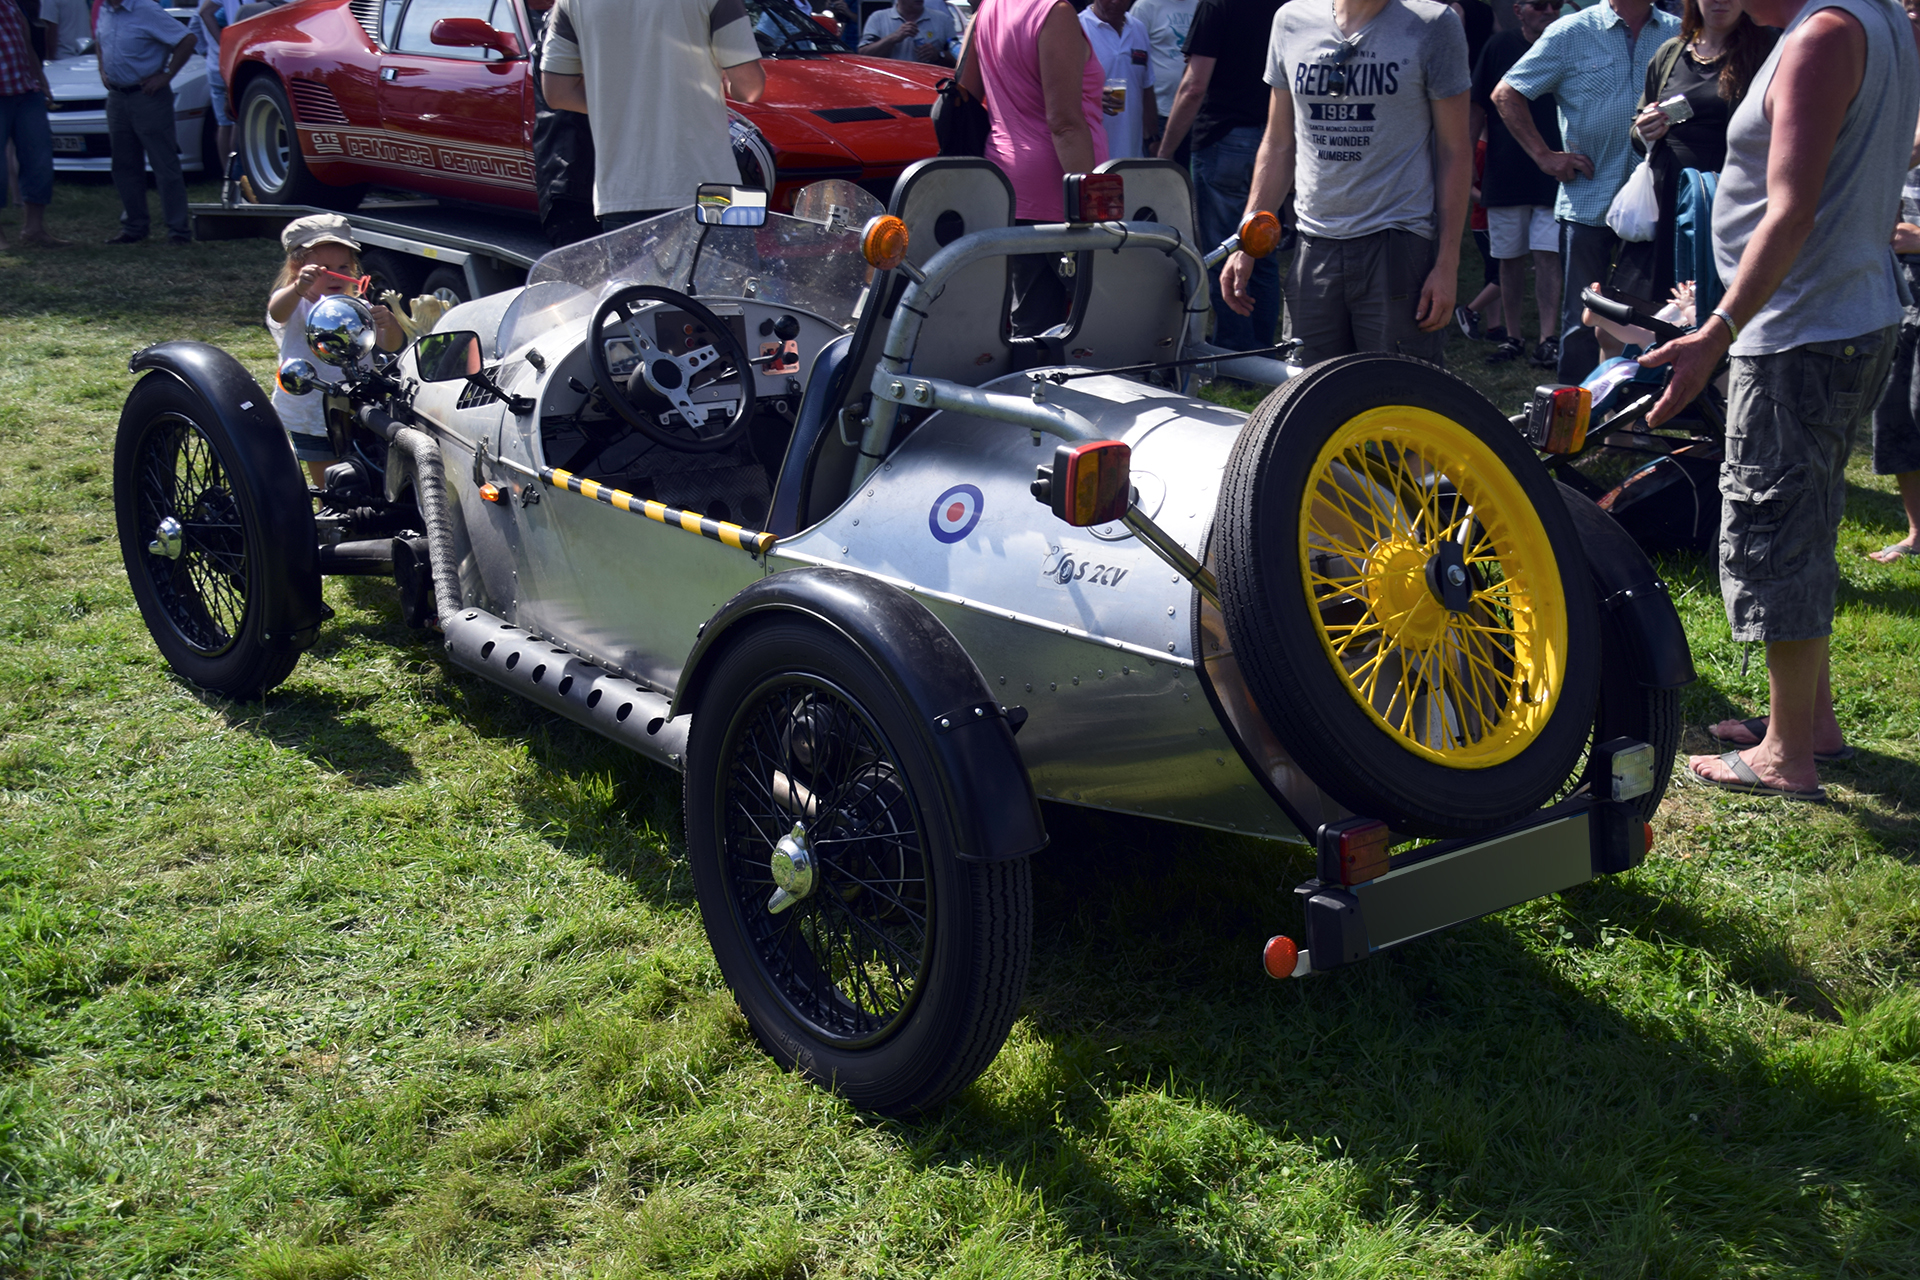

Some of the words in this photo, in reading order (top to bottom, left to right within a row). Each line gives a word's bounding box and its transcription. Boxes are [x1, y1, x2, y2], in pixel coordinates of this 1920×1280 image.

[1318, 50, 1376, 60] CARNIA
[1295, 62, 1399, 96] REDKINS
[1321, 104, 1358, 119] 1984
[1348, 125, 1374, 133] COLLEGE
[311, 132, 340, 144] GTS
[1312, 134, 1327, 145] THE
[1329, 135, 1370, 147] WONDER
[1317, 150, 1362, 162] NUMBERS
[1088, 564, 1129, 587] 2CV
